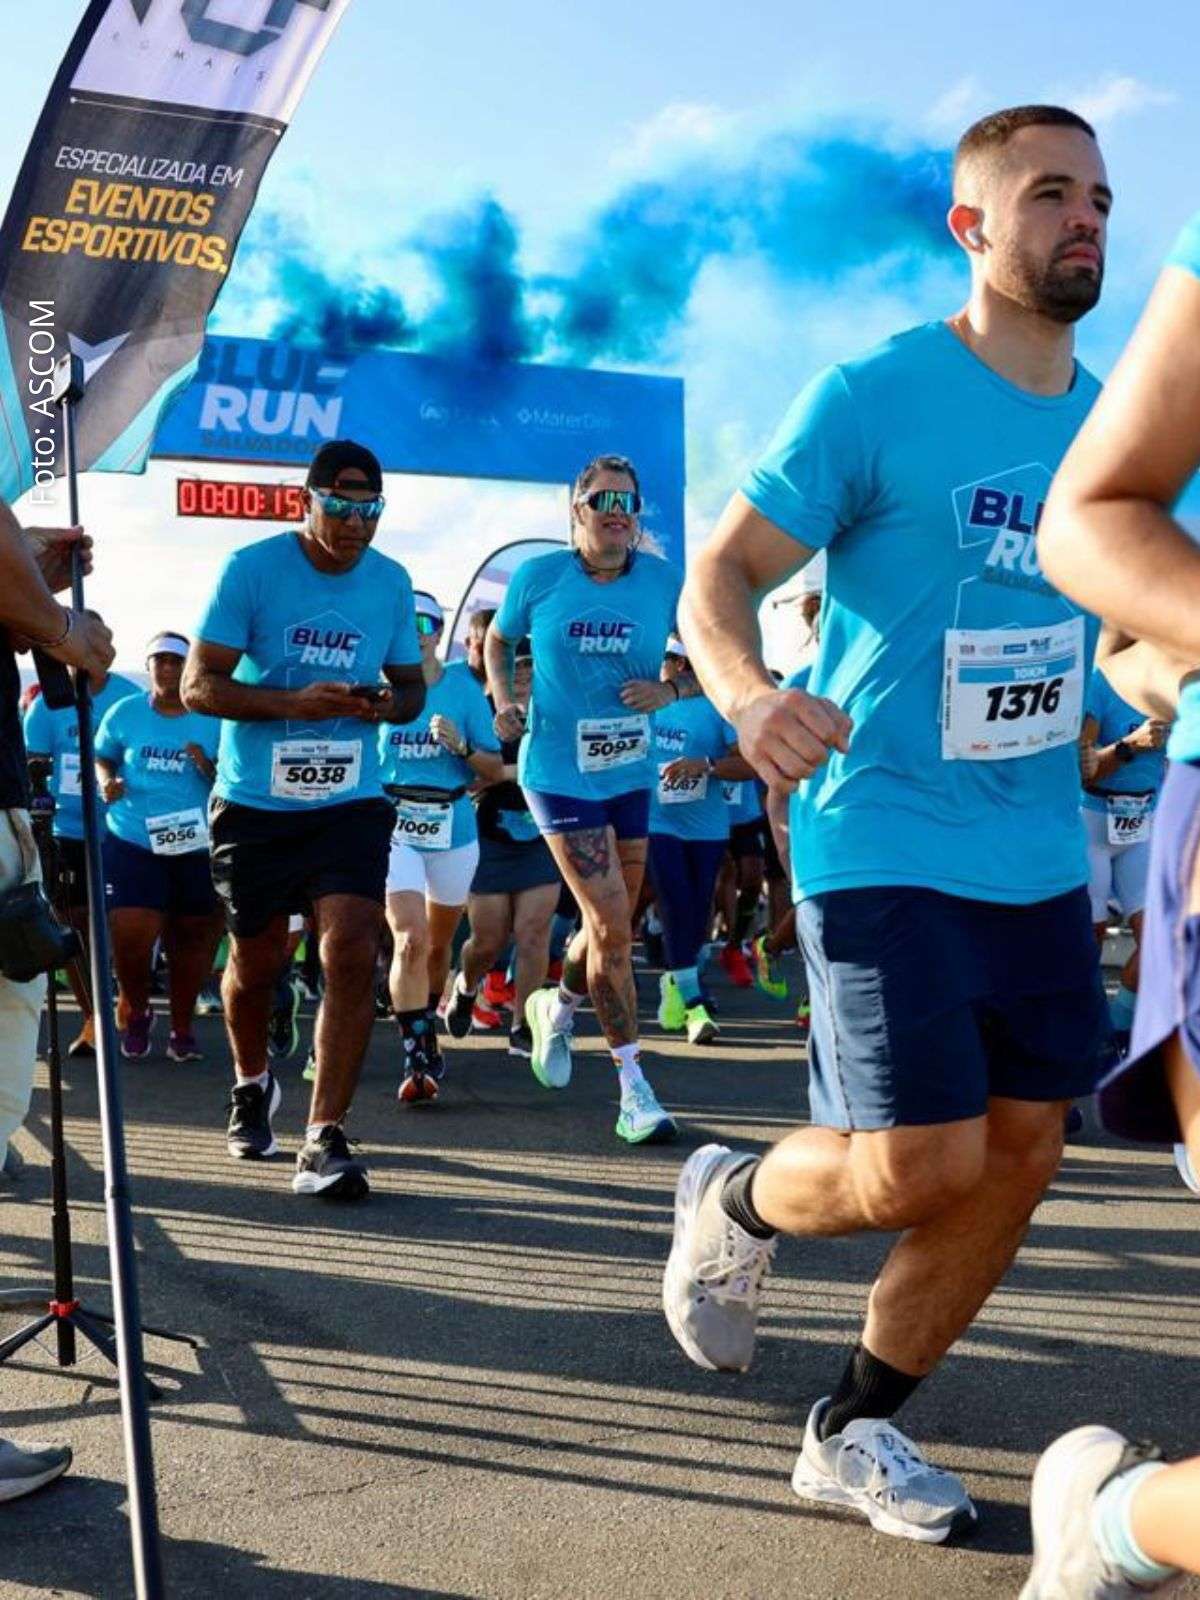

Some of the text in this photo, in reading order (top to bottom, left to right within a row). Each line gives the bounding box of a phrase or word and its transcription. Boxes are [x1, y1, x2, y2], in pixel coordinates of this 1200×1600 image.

[54, 146, 245, 188] ESPECIALIZADA EM
[64, 178, 216, 227] EVENTOS
[21, 216, 229, 275] ESPORTIVOS.
[198, 384, 343, 439] RUN
[984, 527, 1045, 578] RU
[291, 628, 362, 650] BLUE
[568, 621, 638, 638] BLUE
[579, 636, 633, 653] RUN
[301, 645, 356, 669] RUN
[985, 677, 1064, 722] 1316
[398, 744, 442, 759] RUN
[587, 738, 640, 757] 5093
[147, 758, 186, 773] RUN
[285, 766, 347, 784] 5038
[155, 827, 196, 846] 5056
[397, 819, 441, 835] 1006
